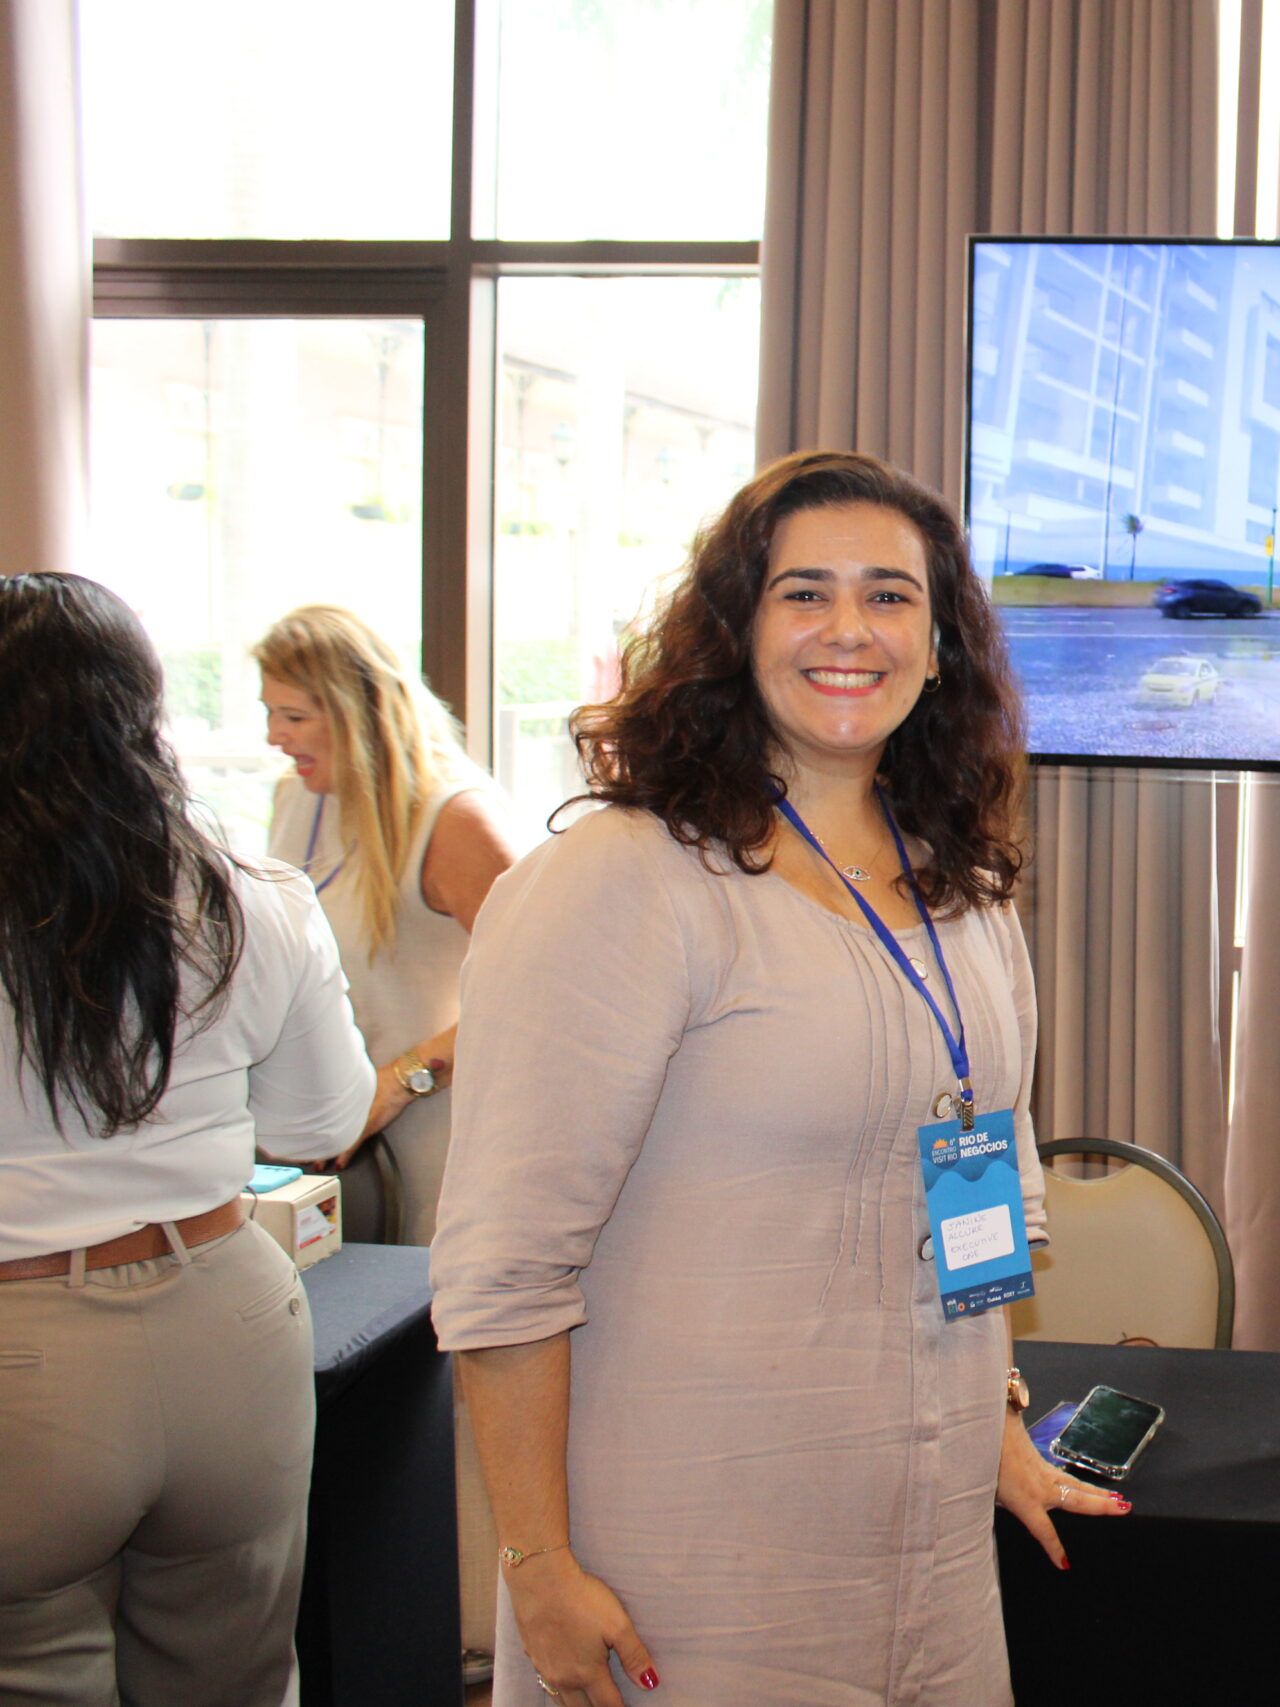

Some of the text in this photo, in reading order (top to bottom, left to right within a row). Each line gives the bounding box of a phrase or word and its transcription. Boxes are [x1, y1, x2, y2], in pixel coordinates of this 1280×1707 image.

[958, 1131, 989, 1147] RIO DE
[960, 1139, 1008, 1158] NEGOCIOS
